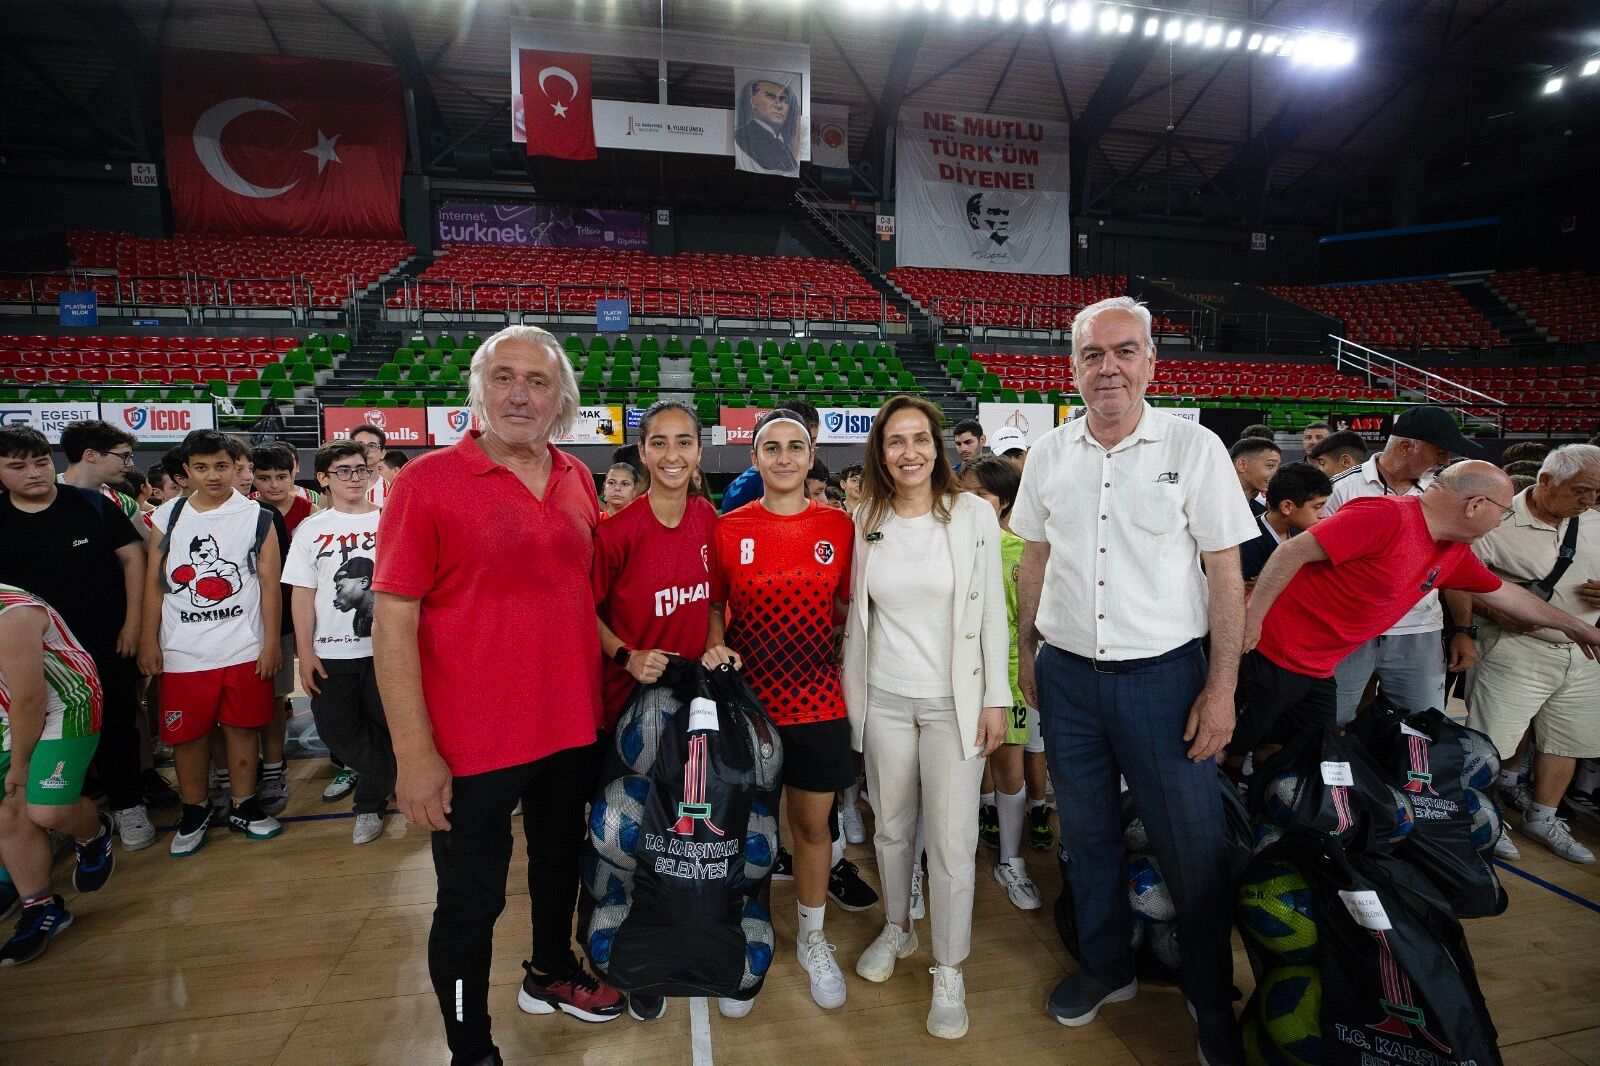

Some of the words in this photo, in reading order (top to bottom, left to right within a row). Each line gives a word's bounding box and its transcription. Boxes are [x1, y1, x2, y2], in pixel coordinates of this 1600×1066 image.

[923, 111, 957, 133] NE
[963, 116, 1044, 142] MUTLU
[928, 135, 1040, 166] TÜRK'ÜM
[133, 175, 157, 185] BLOK
[937, 162, 1035, 190] DİYENE!
[659, 213, 669, 222] C2
[439, 221, 527, 243] turknet
[579, 410, 601, 419] MAK
[313, 531, 377, 566] 2pa
[740, 538, 755, 565] 8
[180, 605, 243, 623] BOXING
[1012, 705, 1027, 729] 12
[646, 833, 666, 852] T.C.
[668, 838, 740, 861] KARŞIYAKA
[654, 857, 729, 880] BELEDİYESİ
[1335, 1023, 1371, 1050] T.C.
